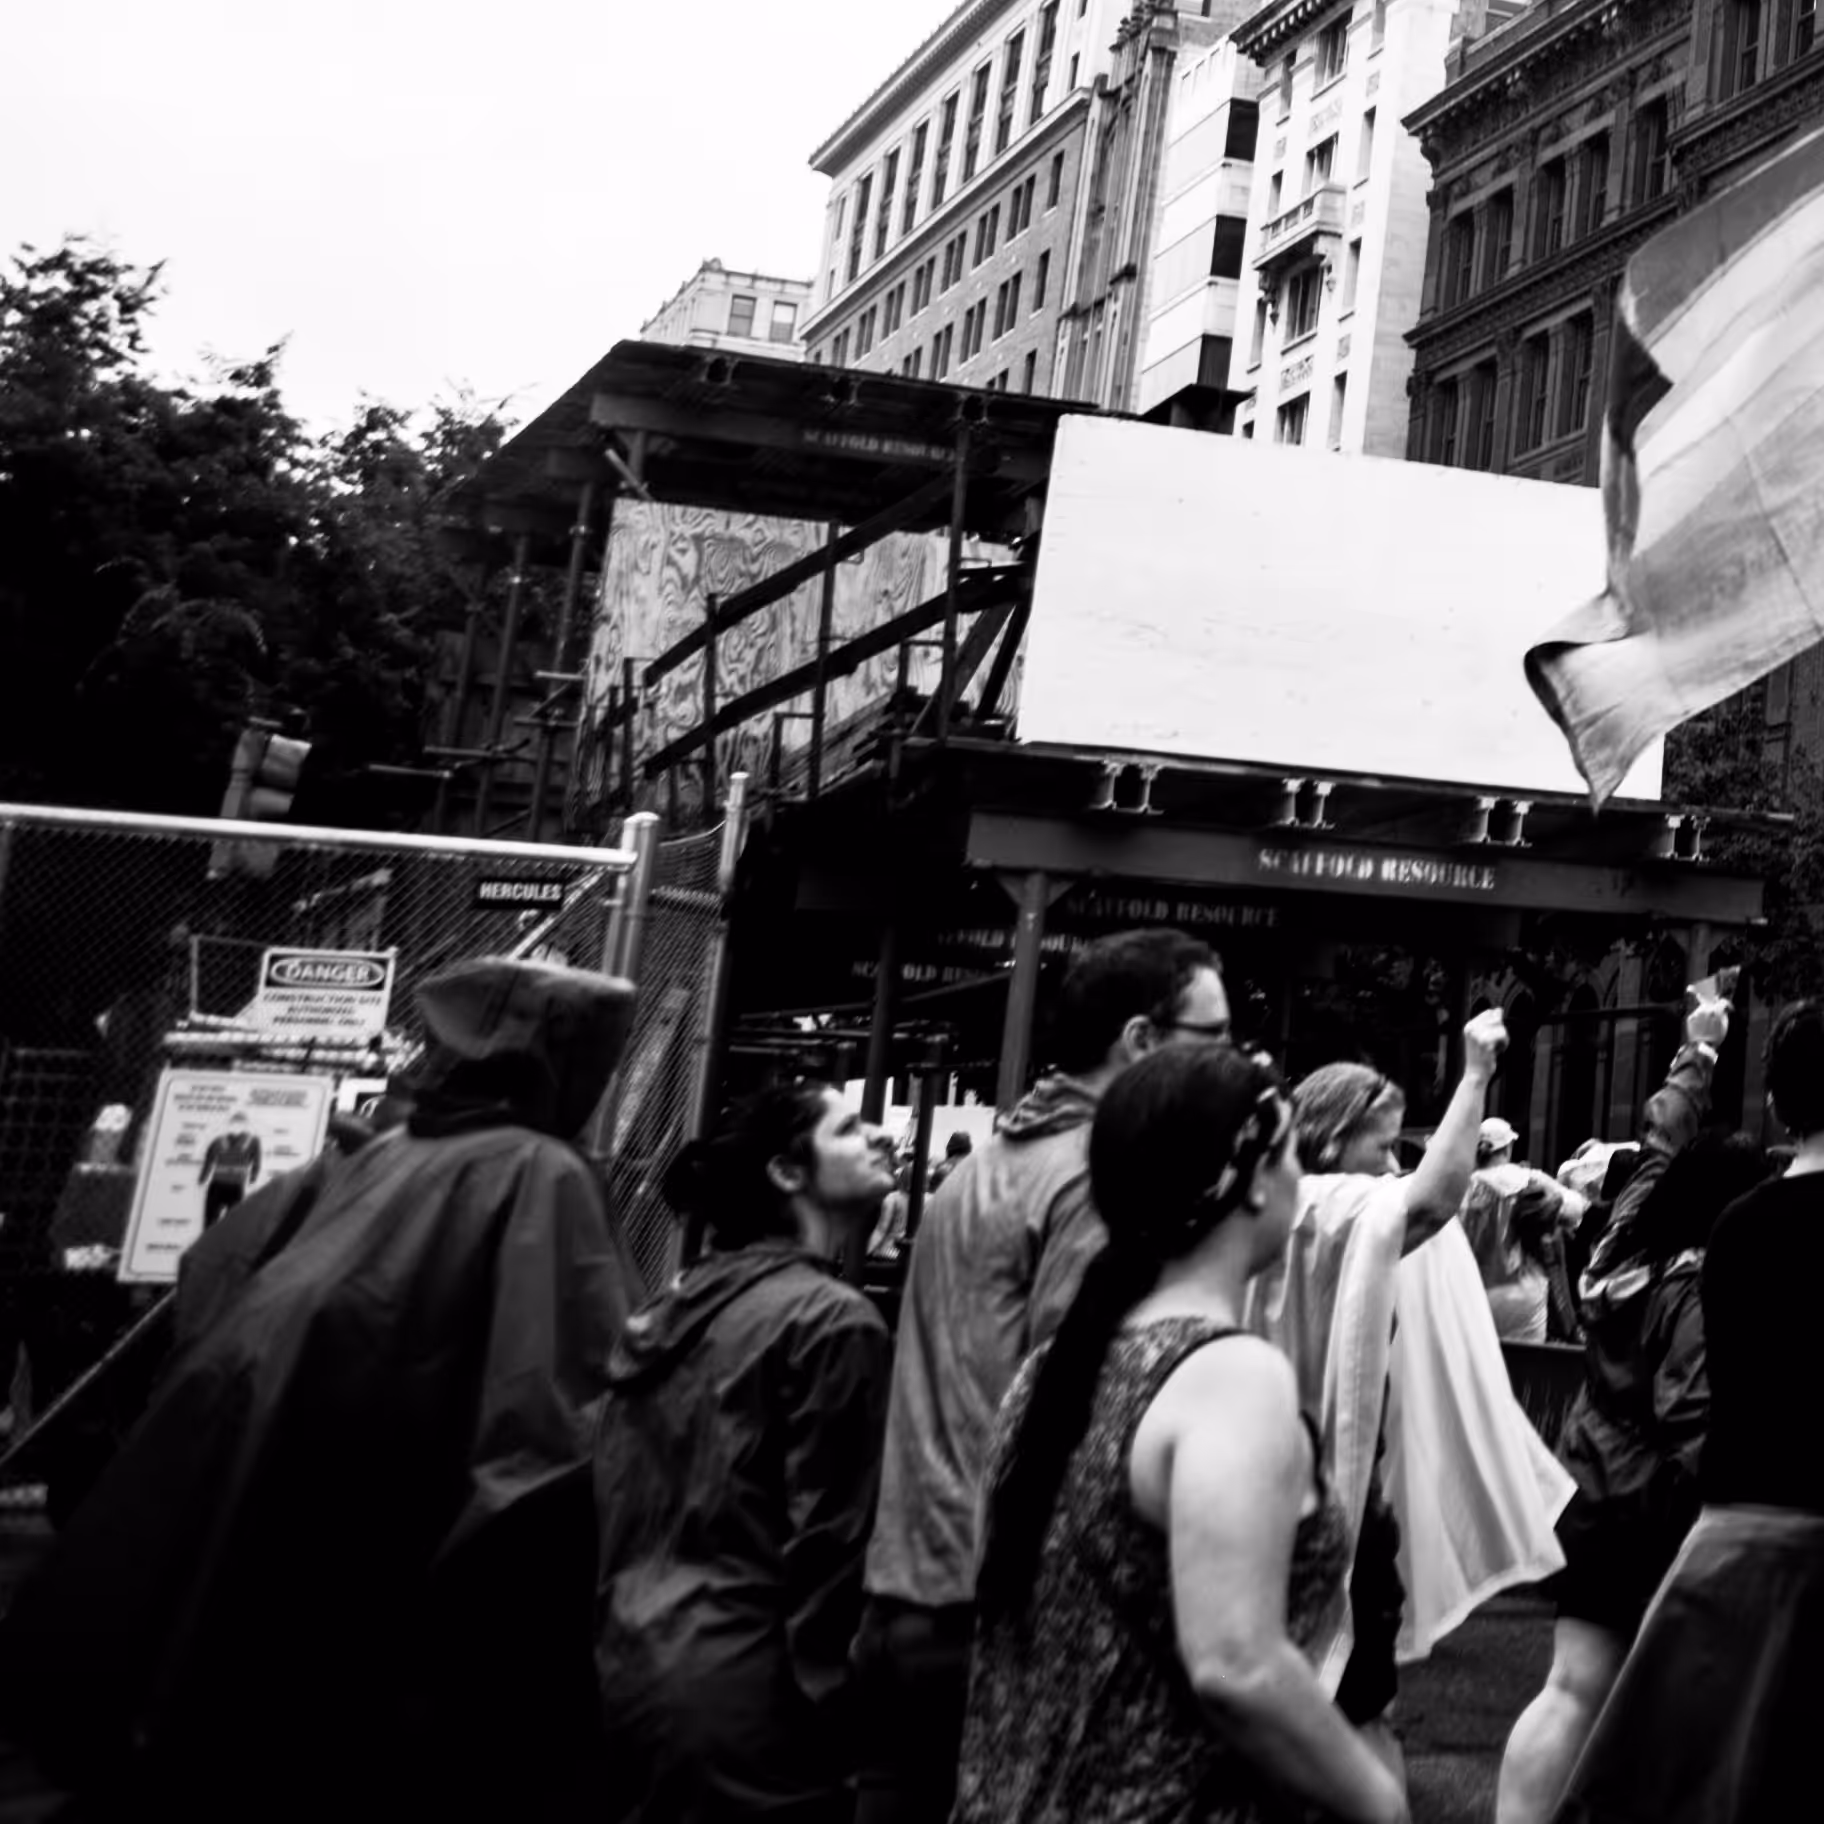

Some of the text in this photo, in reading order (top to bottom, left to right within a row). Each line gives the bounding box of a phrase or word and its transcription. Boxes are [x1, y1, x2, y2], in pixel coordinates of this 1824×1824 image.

[1258, 848, 1496, 890] SCAFFOLD RESOURCE
[479, 882, 562, 902] HERCULES
[284, 959, 372, 982] DANGER
